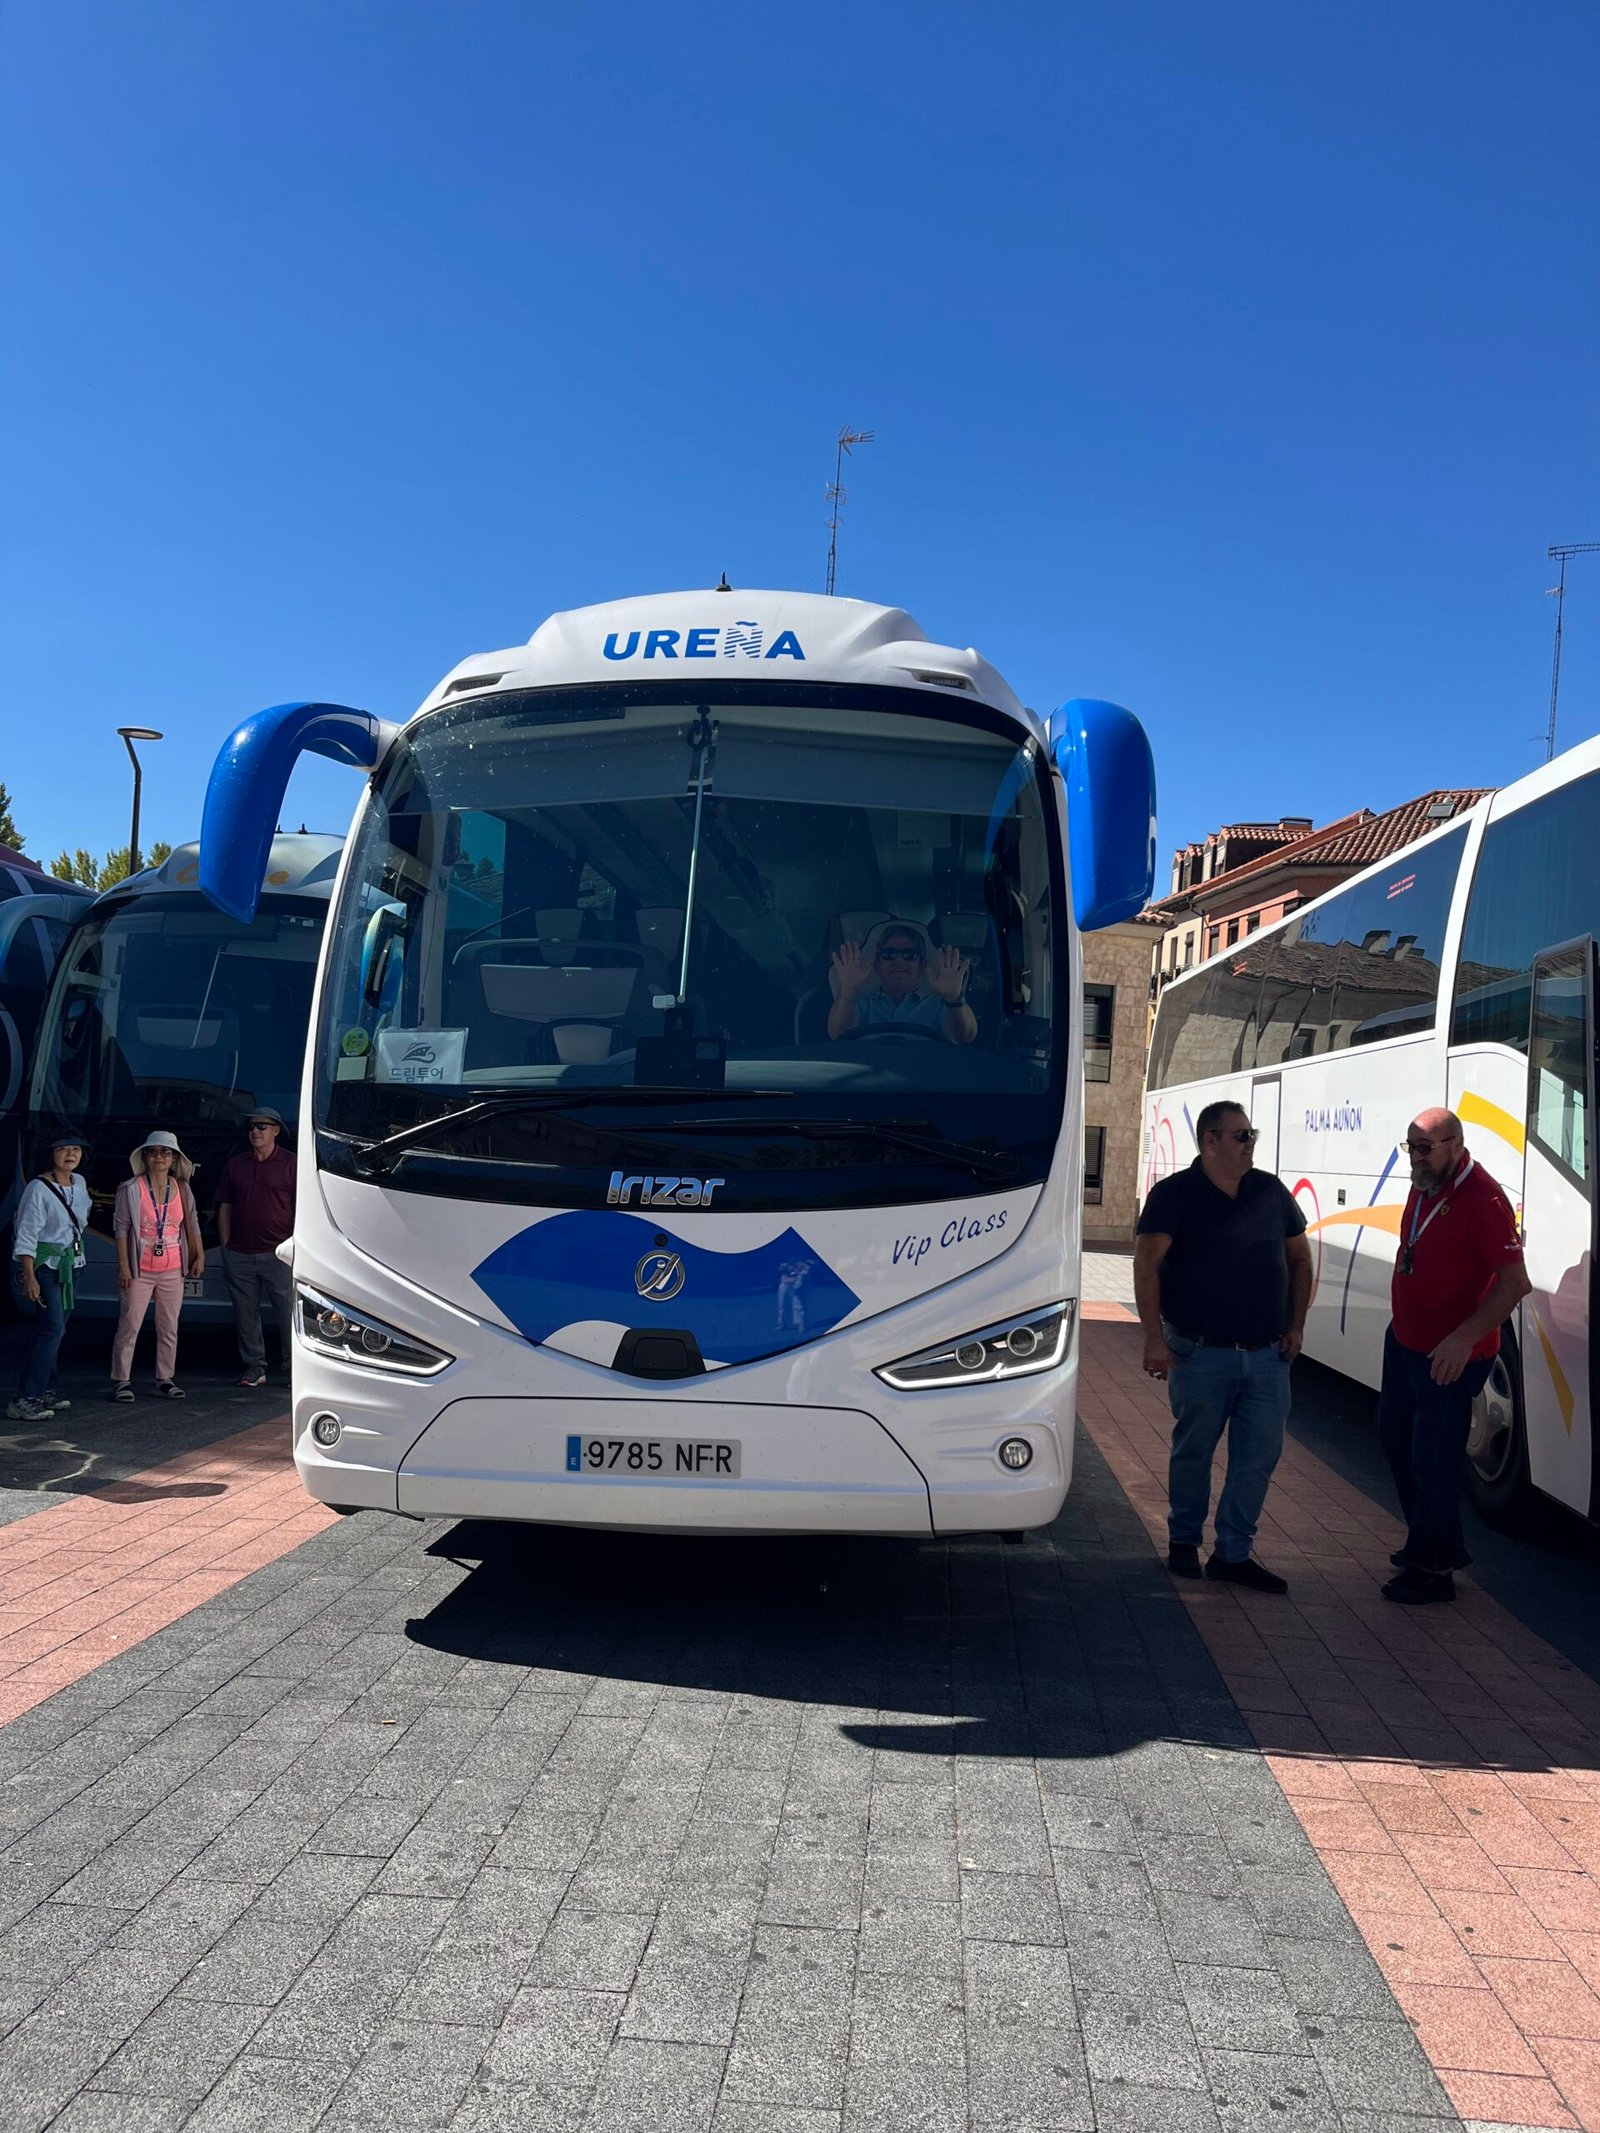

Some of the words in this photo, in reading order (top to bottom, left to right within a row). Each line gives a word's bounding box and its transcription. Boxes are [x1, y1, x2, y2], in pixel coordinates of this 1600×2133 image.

[602, 620, 806, 660] UREÑA
[389, 1067, 444, 1083] 드림투어
[1305, 1109, 1330, 1132] PALMA
[606, 1171, 725, 1206] Irizar
[892, 1235, 932, 1266] Vip
[940, 1210, 1008, 1248] Class
[183, 1281, 200, 1295] FT
[588, 1441, 663, 1470] 9785
[676, 1443, 732, 1473] NFR
